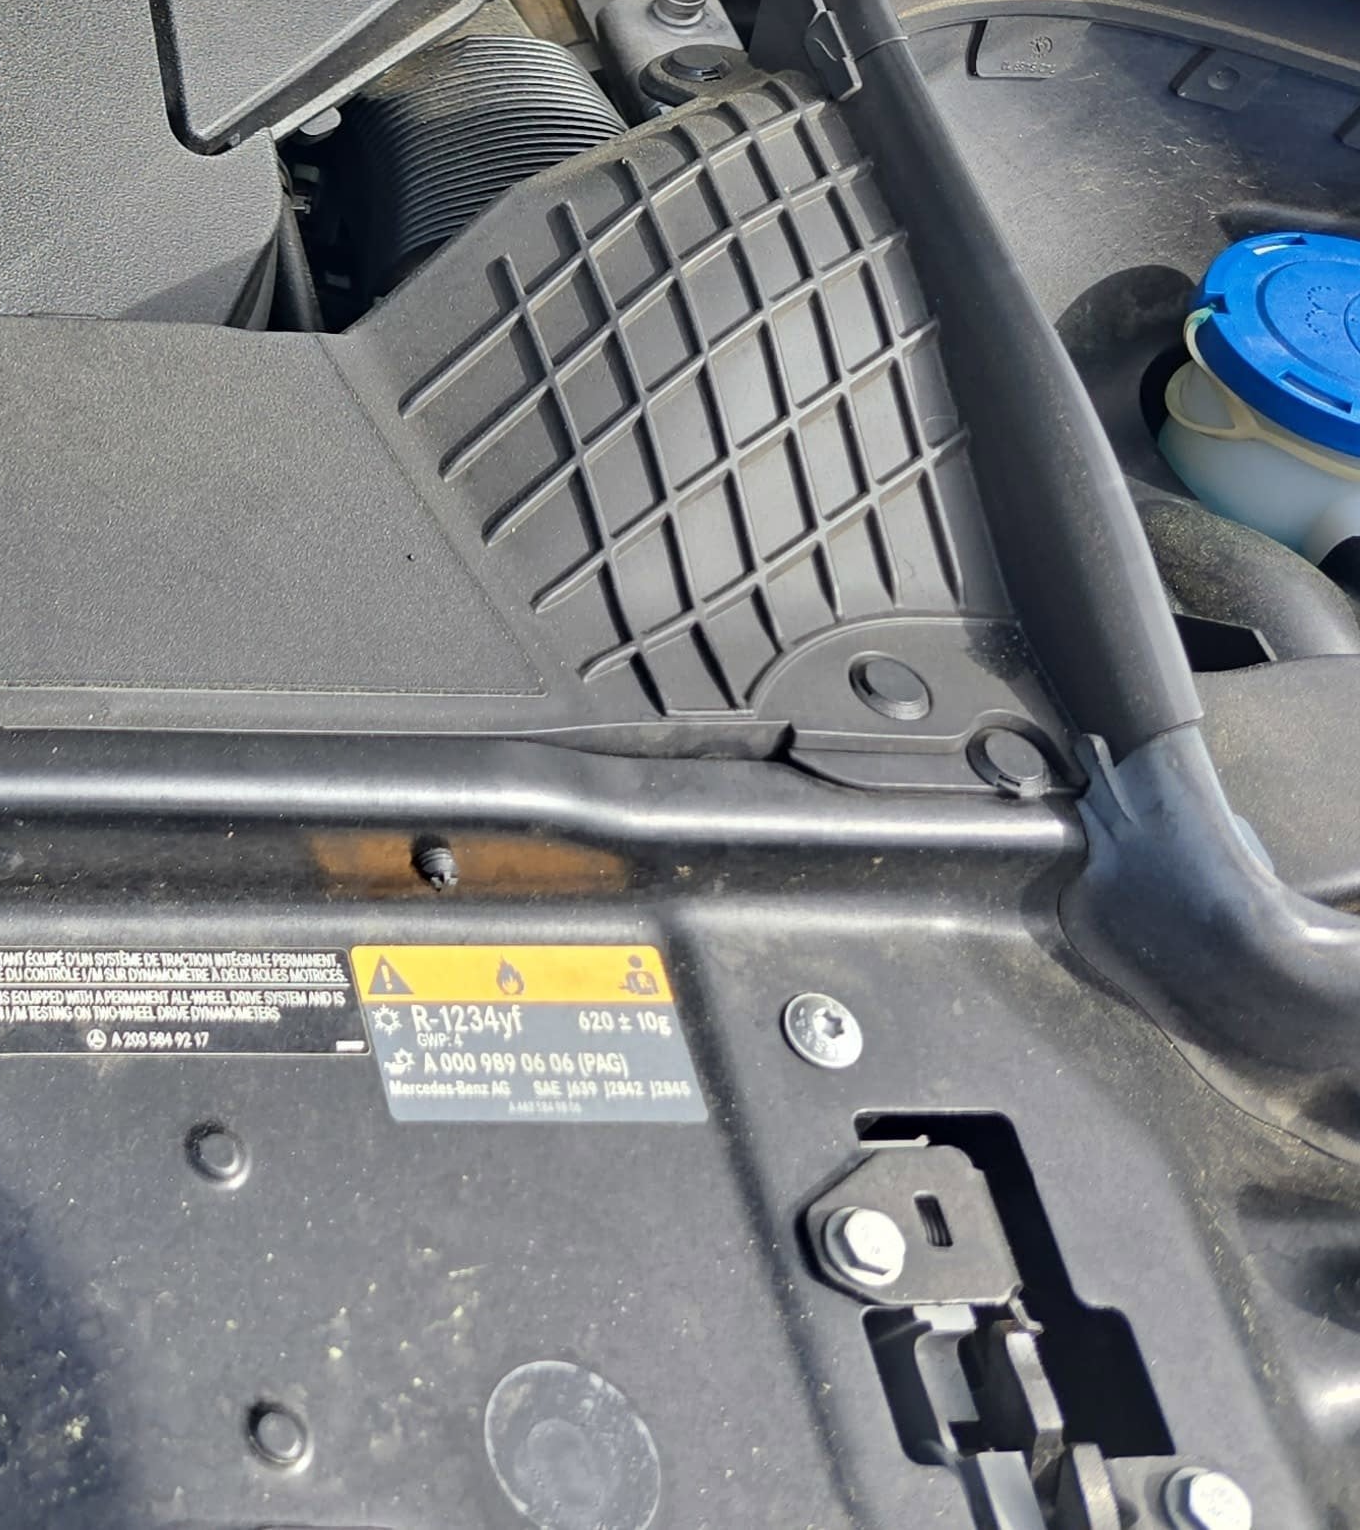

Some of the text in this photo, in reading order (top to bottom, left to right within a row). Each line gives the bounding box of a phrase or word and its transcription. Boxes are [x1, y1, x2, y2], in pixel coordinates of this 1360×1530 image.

[25, 950, 65, 967] ÉQUIPÉ
[95, 949, 144, 967] SYSTÈME
[143, 953, 160, 966] DE
[161, 953, 214, 968] TRACTION
[213, 950, 272, 968] INTÉGRALE
[5, 968, 23, 981] DU
[104, 968, 128, 982] SUR
[222, 968, 252, 982] DEUX
[252, 968, 289, 982] ROUES
[11, 990, 65, 1005] EQUIPPED
[64, 990, 95, 1006] WITH
[104, 990, 171, 1006] PERMANENT
[171, 991, 231, 1006] ALL-WHEEL
[231, 991, 264, 1006] DRIVE
[264, 991, 308, 1007] SYSTEM
[308, 991, 333, 1007] AND
[333, 991, 347, 1007] IS
[27, 1006, 74, 1022] TESTING
[73, 1006, 94, 1022] ON
[93, 1006, 157, 1022] TWO-WHEEL
[156, 1006, 190, 1022] DRIVE
[190, 1006, 281, 1022] DYNAMOMETERS
[410, 1004, 523, 1041] R-1234yf
[578, 1011, 615, 1032] 620
[636, 1011, 673, 1037] 10g
[111, 1031, 210, 1049] A 203 584 92 17
[416, 1033, 464, 1047] GWP: 4
[424, 1051, 629, 1079] A 000 989 06 06 (PAG)
[389, 1080, 490, 1098] Mercedes-Benz
[491, 1080, 513, 1097] AG
[533, 1080, 562, 1097] SAE
